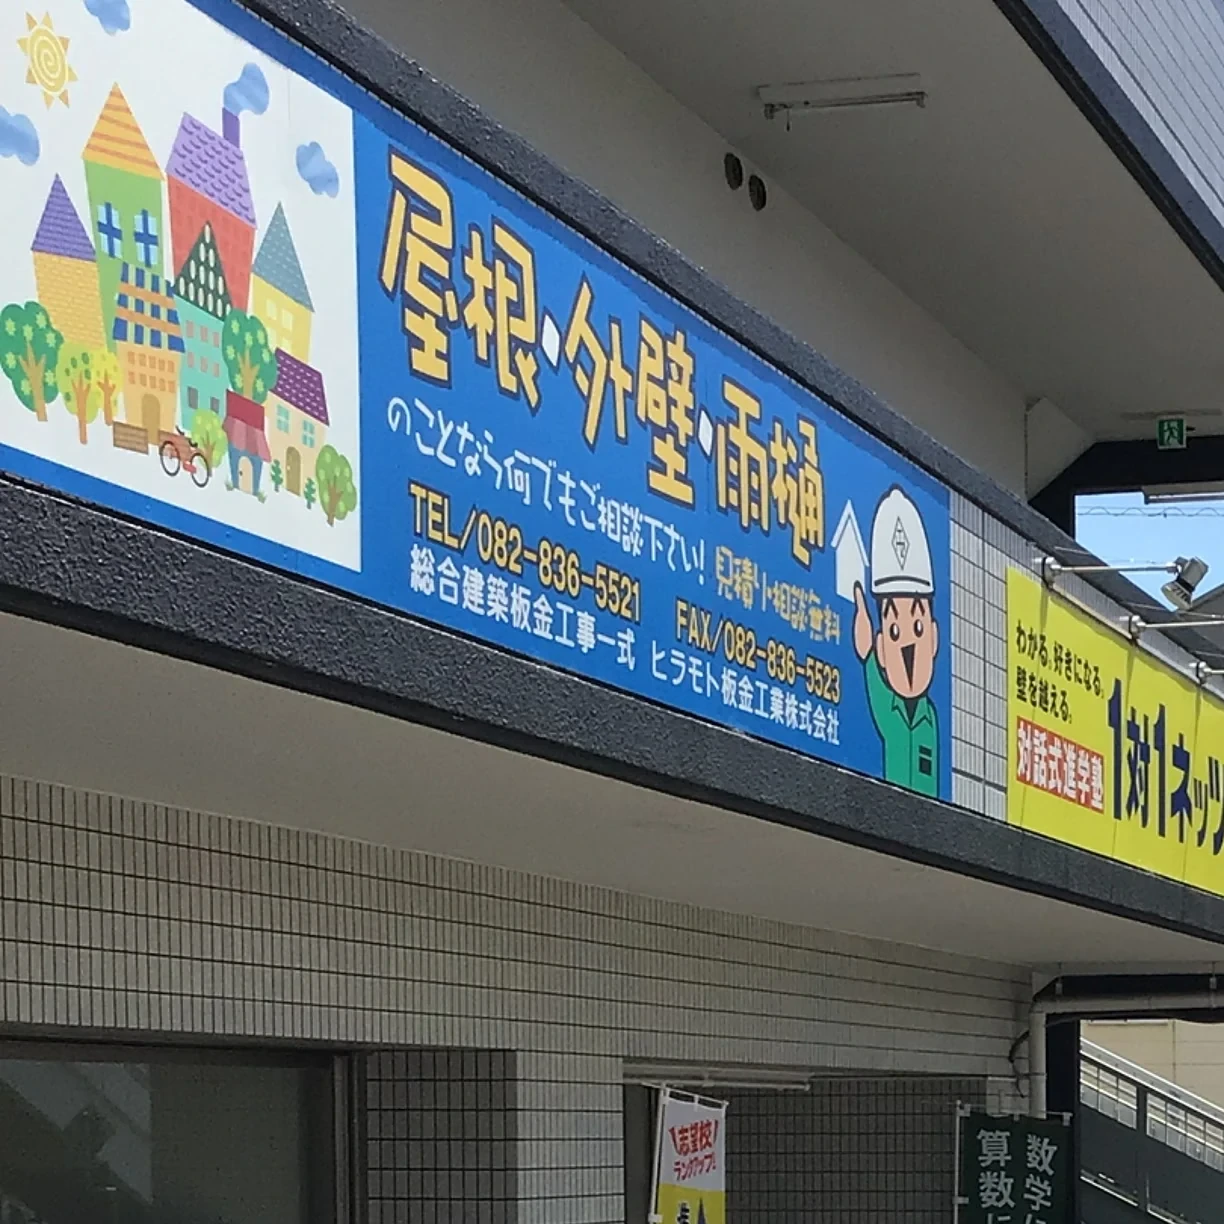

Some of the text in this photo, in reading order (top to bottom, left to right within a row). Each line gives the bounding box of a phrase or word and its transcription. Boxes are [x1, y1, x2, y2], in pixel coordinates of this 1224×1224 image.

[408, 480, 842, 704] TEL/082-836-5521 FAX/082-836-5523
[409, 543, 842, 747] 総合建築板金工事一式 ヒラモト板金工業株式会社
[1017, 720, 1105, 812] 対話式進学塾
